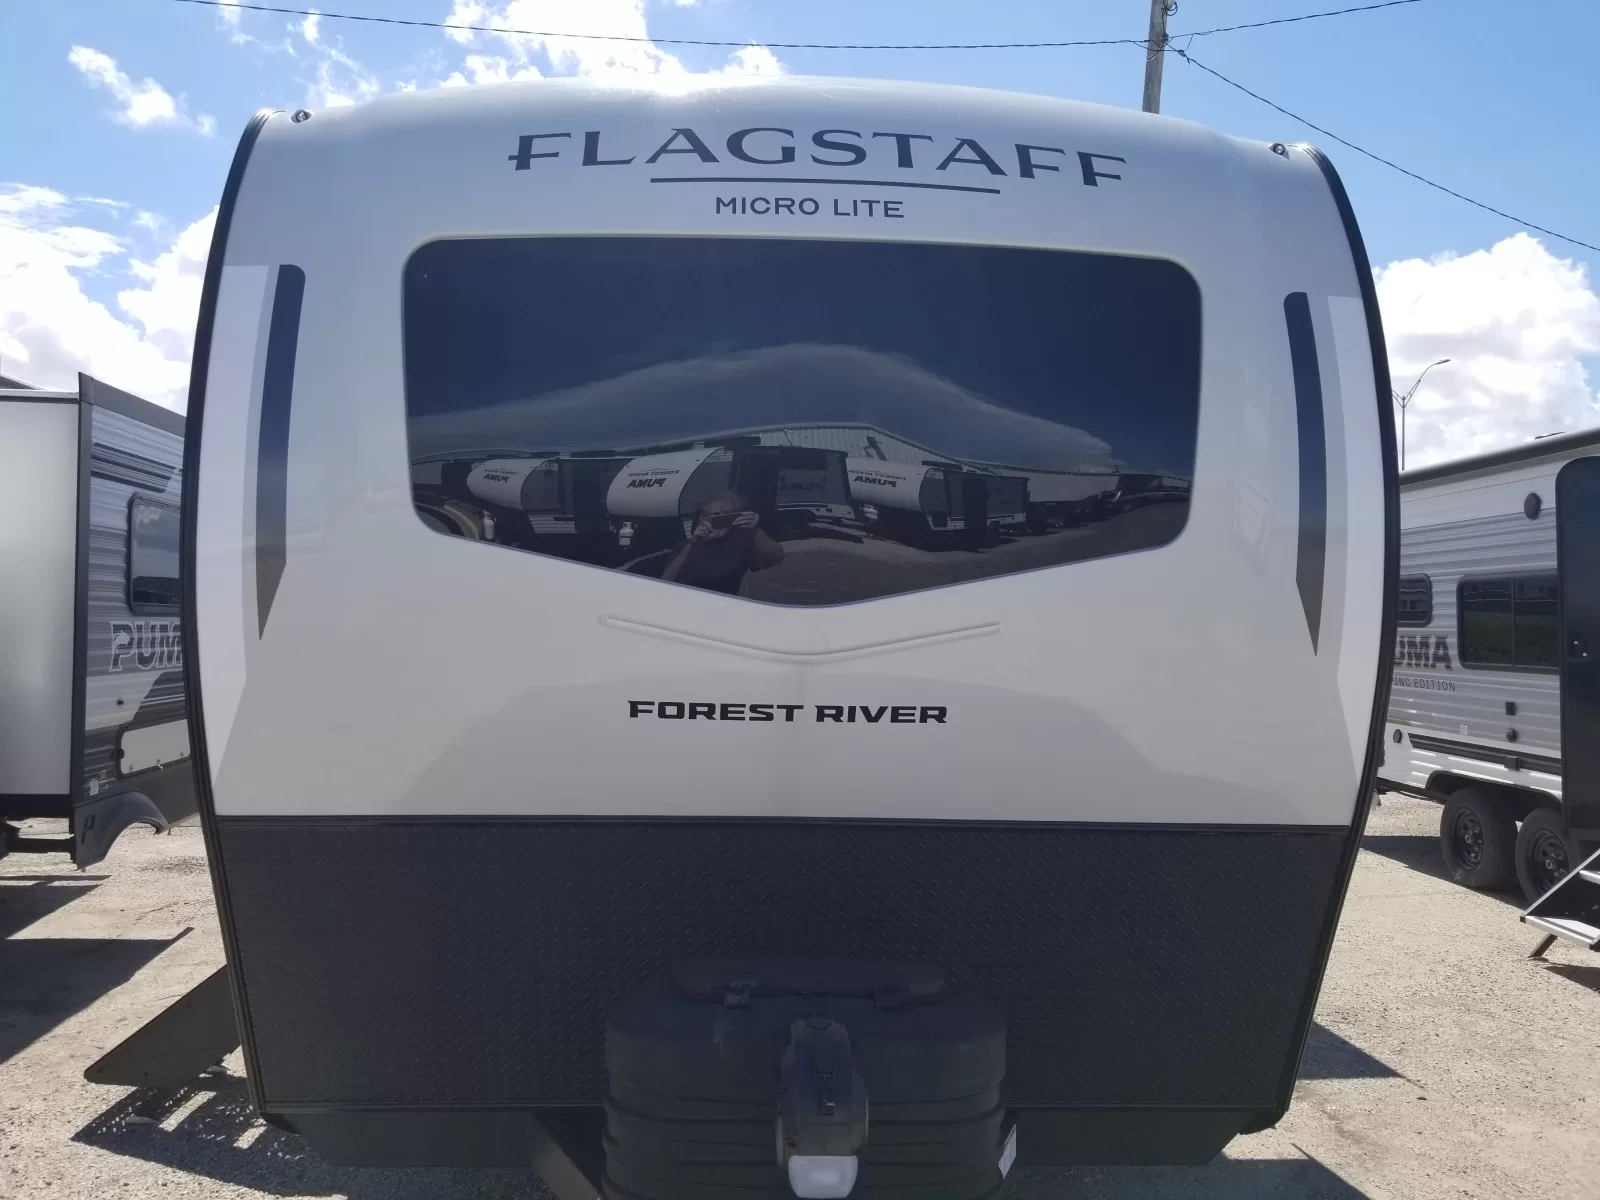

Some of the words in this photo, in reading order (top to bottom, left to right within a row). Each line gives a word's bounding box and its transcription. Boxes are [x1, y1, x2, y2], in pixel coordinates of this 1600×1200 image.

[508, 127, 1127, 188] FLAGSTAFF
[715, 196, 820, 216] MICRO
[833, 198, 905, 219] LITE
[108, 620, 183, 672] PUM
[1394, 635, 1454, 671] UMA
[1413, 678, 1457, 693] EDITION
[627, 699, 805, 723] FOREST
[813, 704, 948, 724] RIVER
